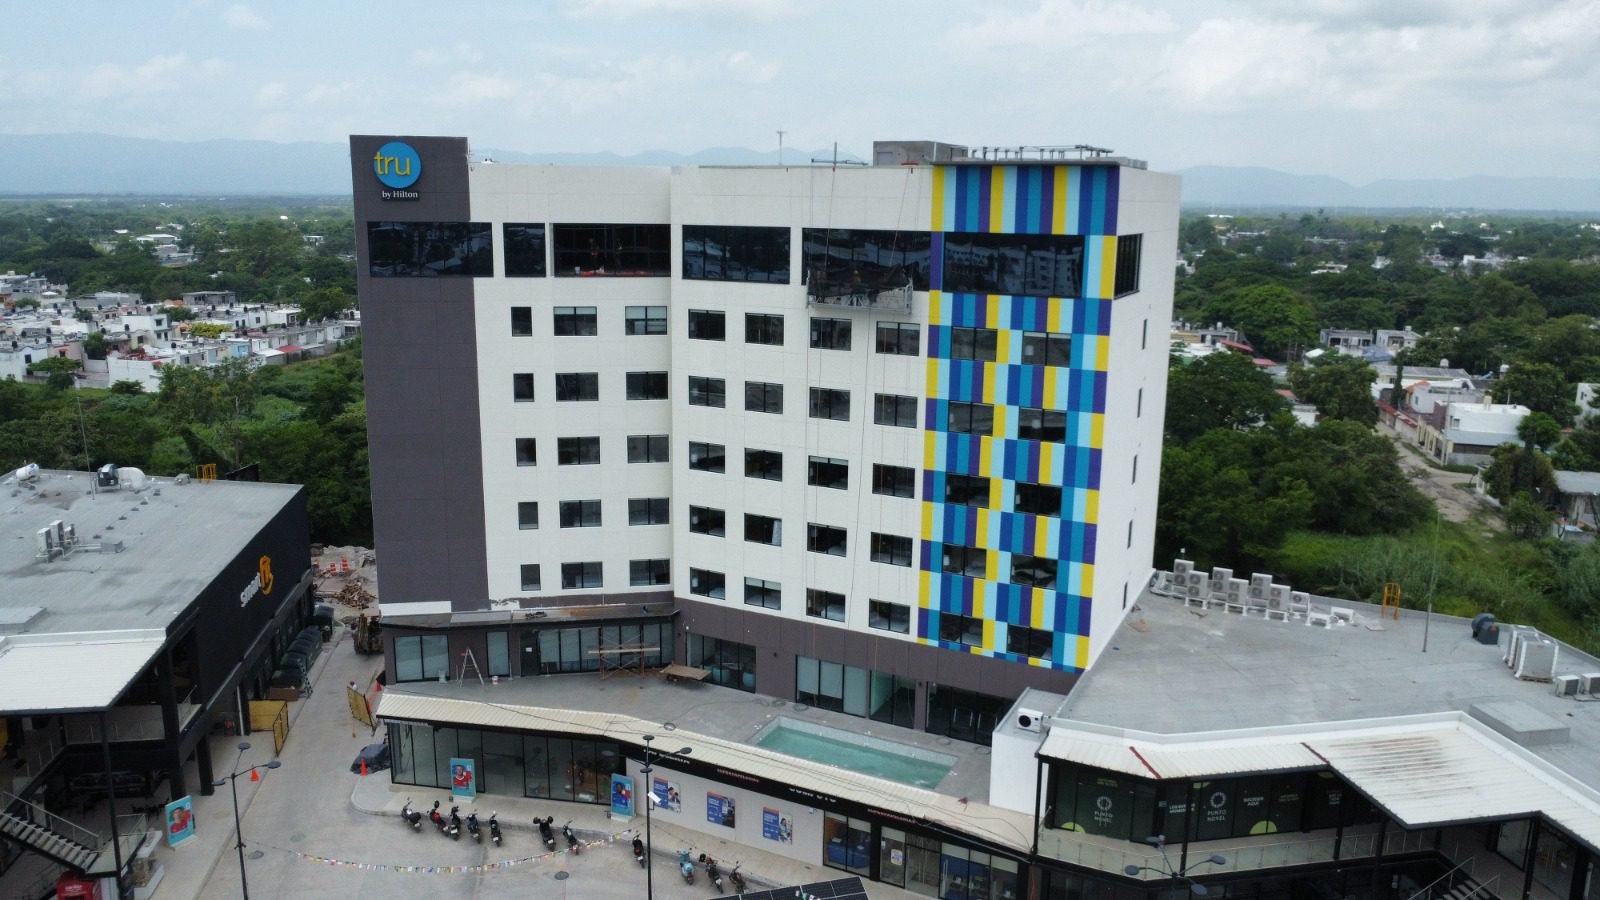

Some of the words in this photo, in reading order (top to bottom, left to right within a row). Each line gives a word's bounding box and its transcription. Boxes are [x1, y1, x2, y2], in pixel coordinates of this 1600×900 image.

[374, 152, 410, 175] tru
[382, 190, 391, 199] by
[393, 190, 418, 198] Hilton
